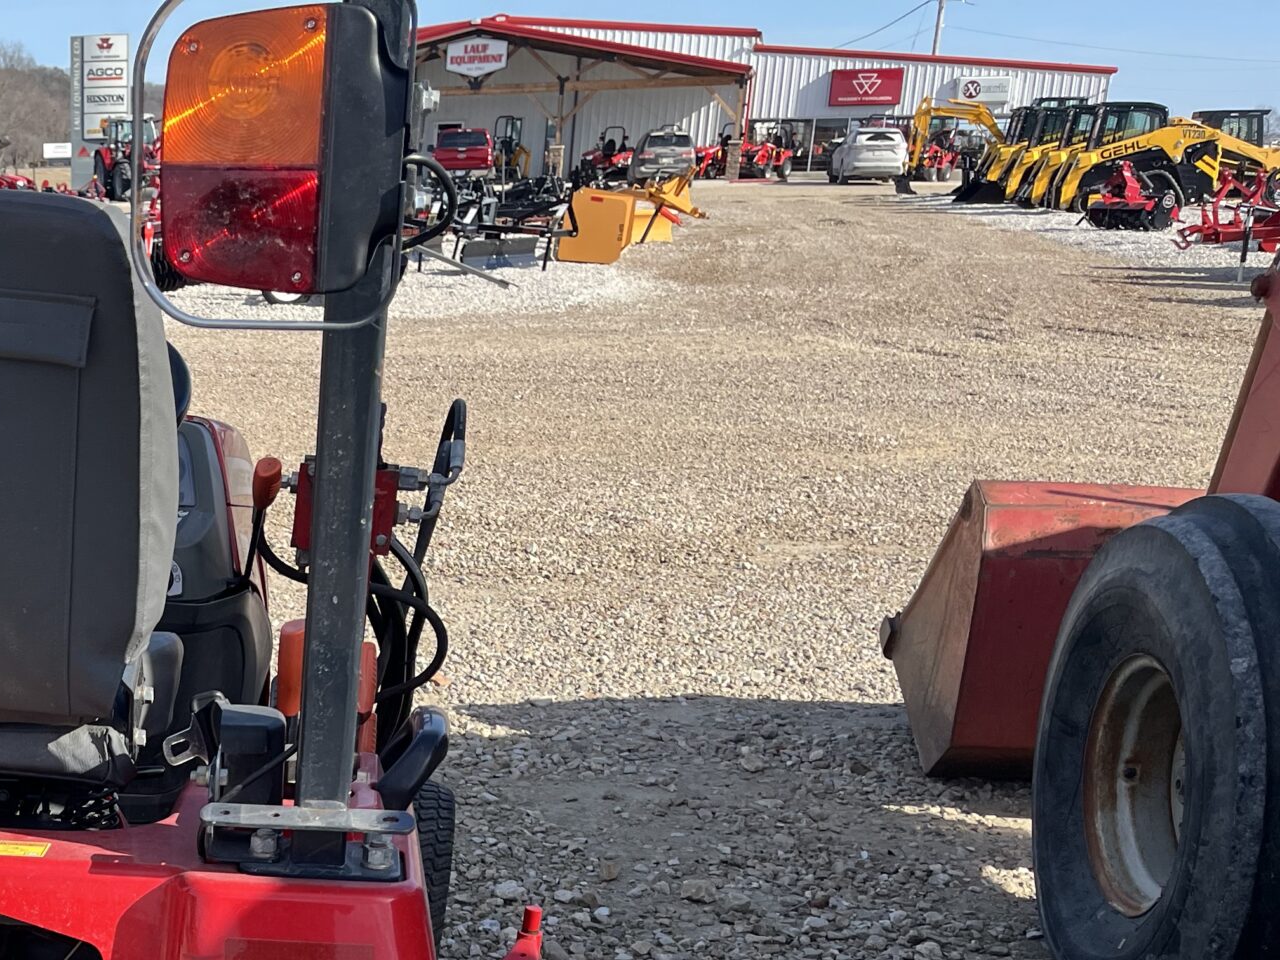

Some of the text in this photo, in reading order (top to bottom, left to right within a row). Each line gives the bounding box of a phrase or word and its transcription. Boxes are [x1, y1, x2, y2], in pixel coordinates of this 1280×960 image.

[464, 43, 489, 54] LAUF
[450, 53, 504, 66] EQUIPMENT
[86, 67, 124, 77] AGCO
[1100, 141, 1147, 159] GEHL
